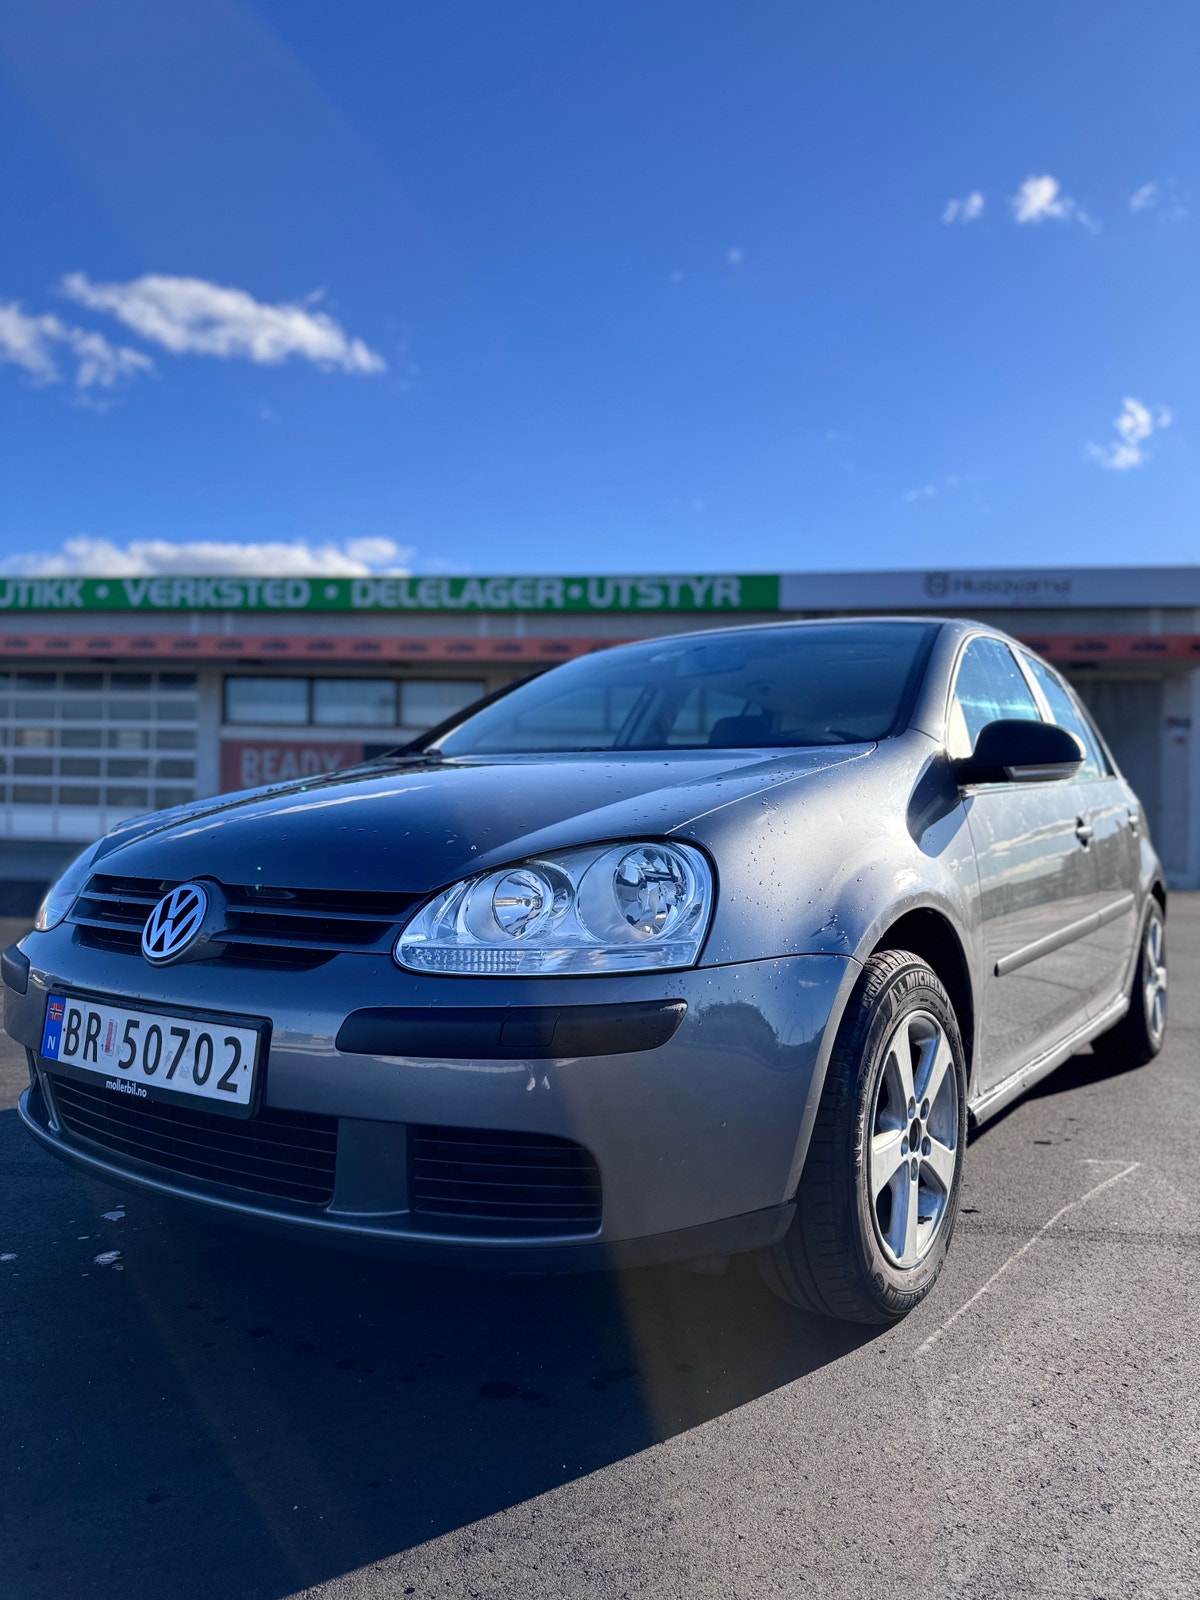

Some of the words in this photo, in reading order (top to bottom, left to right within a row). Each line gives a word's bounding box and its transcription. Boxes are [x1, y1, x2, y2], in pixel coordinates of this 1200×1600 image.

[121, 579, 311, 608] VERKSTED
[350, 578, 565, 608] DELELAGER
[588, 577, 742, 608] UTSTYR
[905, 971, 949, 1003] MICHELIN
[47, 1034, 56, 1050] N
[63, 1008, 102, 1063] BR
[118, 1019, 243, 1094] 50702
[105, 1079, 148, 1098] mollerbil.no
